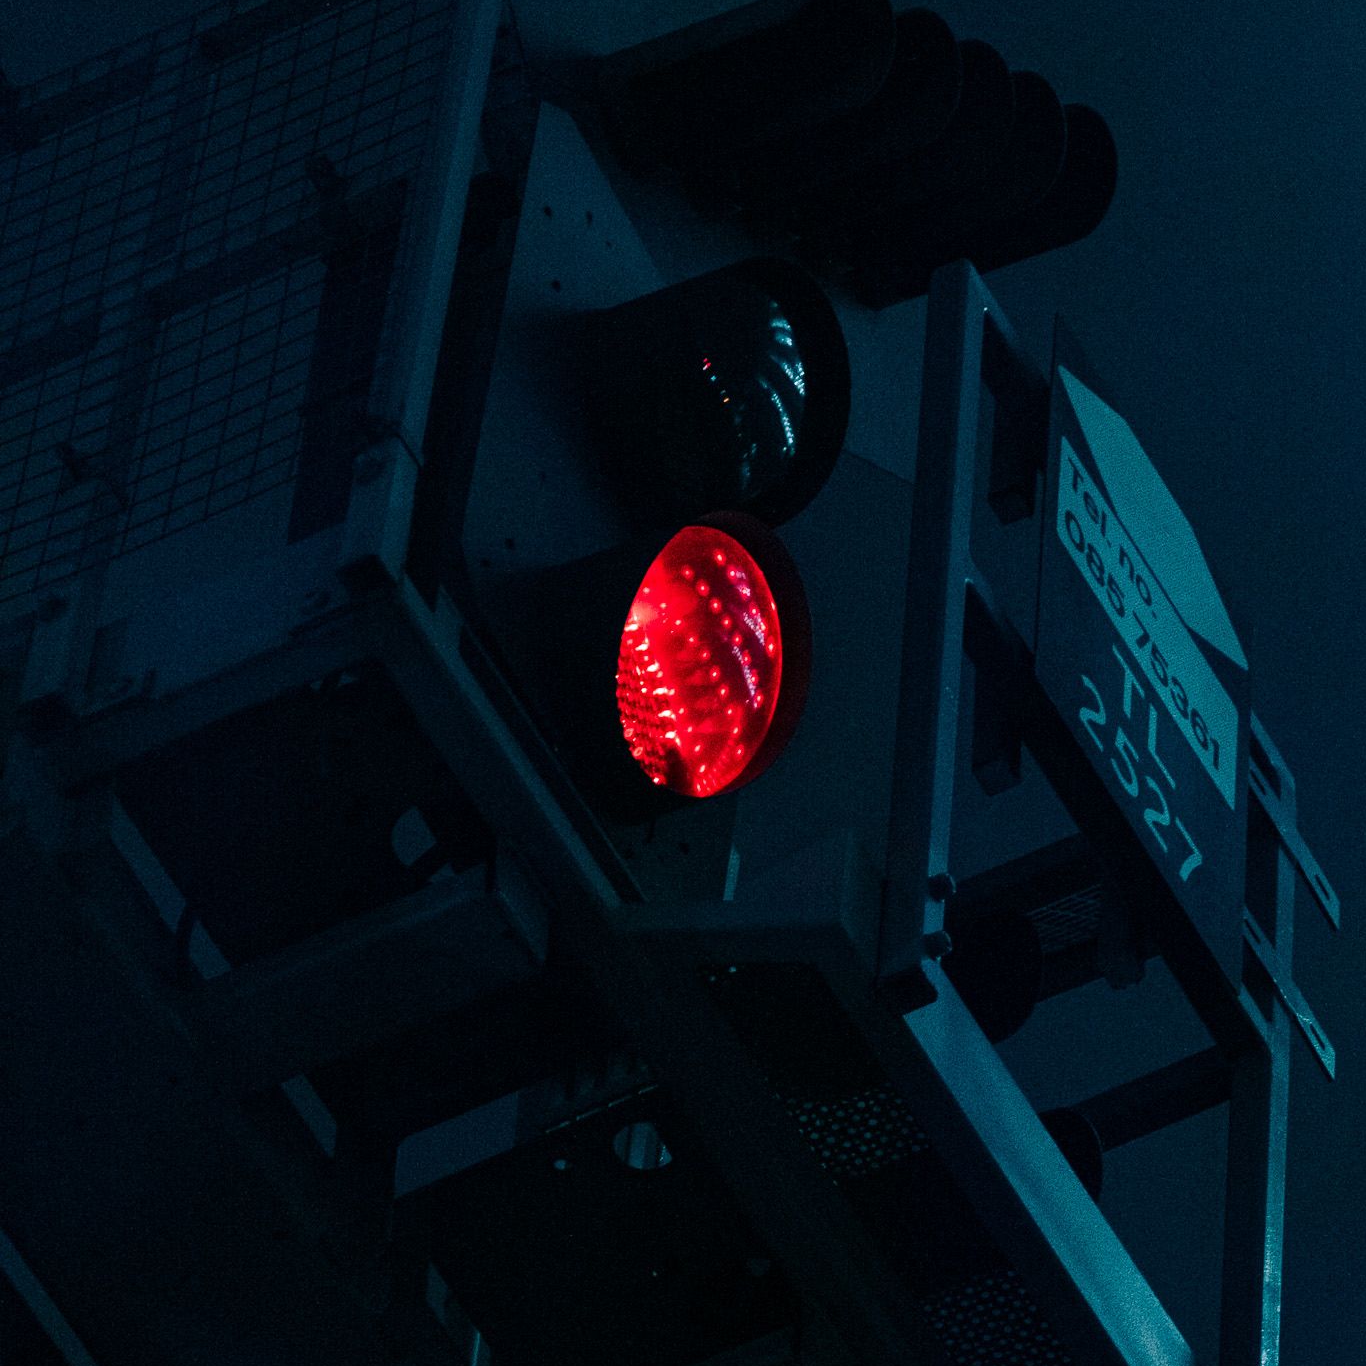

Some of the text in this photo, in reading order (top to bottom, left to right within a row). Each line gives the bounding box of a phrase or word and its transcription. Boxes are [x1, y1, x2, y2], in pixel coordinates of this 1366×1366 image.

[1068, 458, 1157, 618] Tel. no.
[1064, 509, 1220, 770] 085 75361
[1112, 645, 1177, 790] TL
[1078, 675, 1203, 882] 2527
